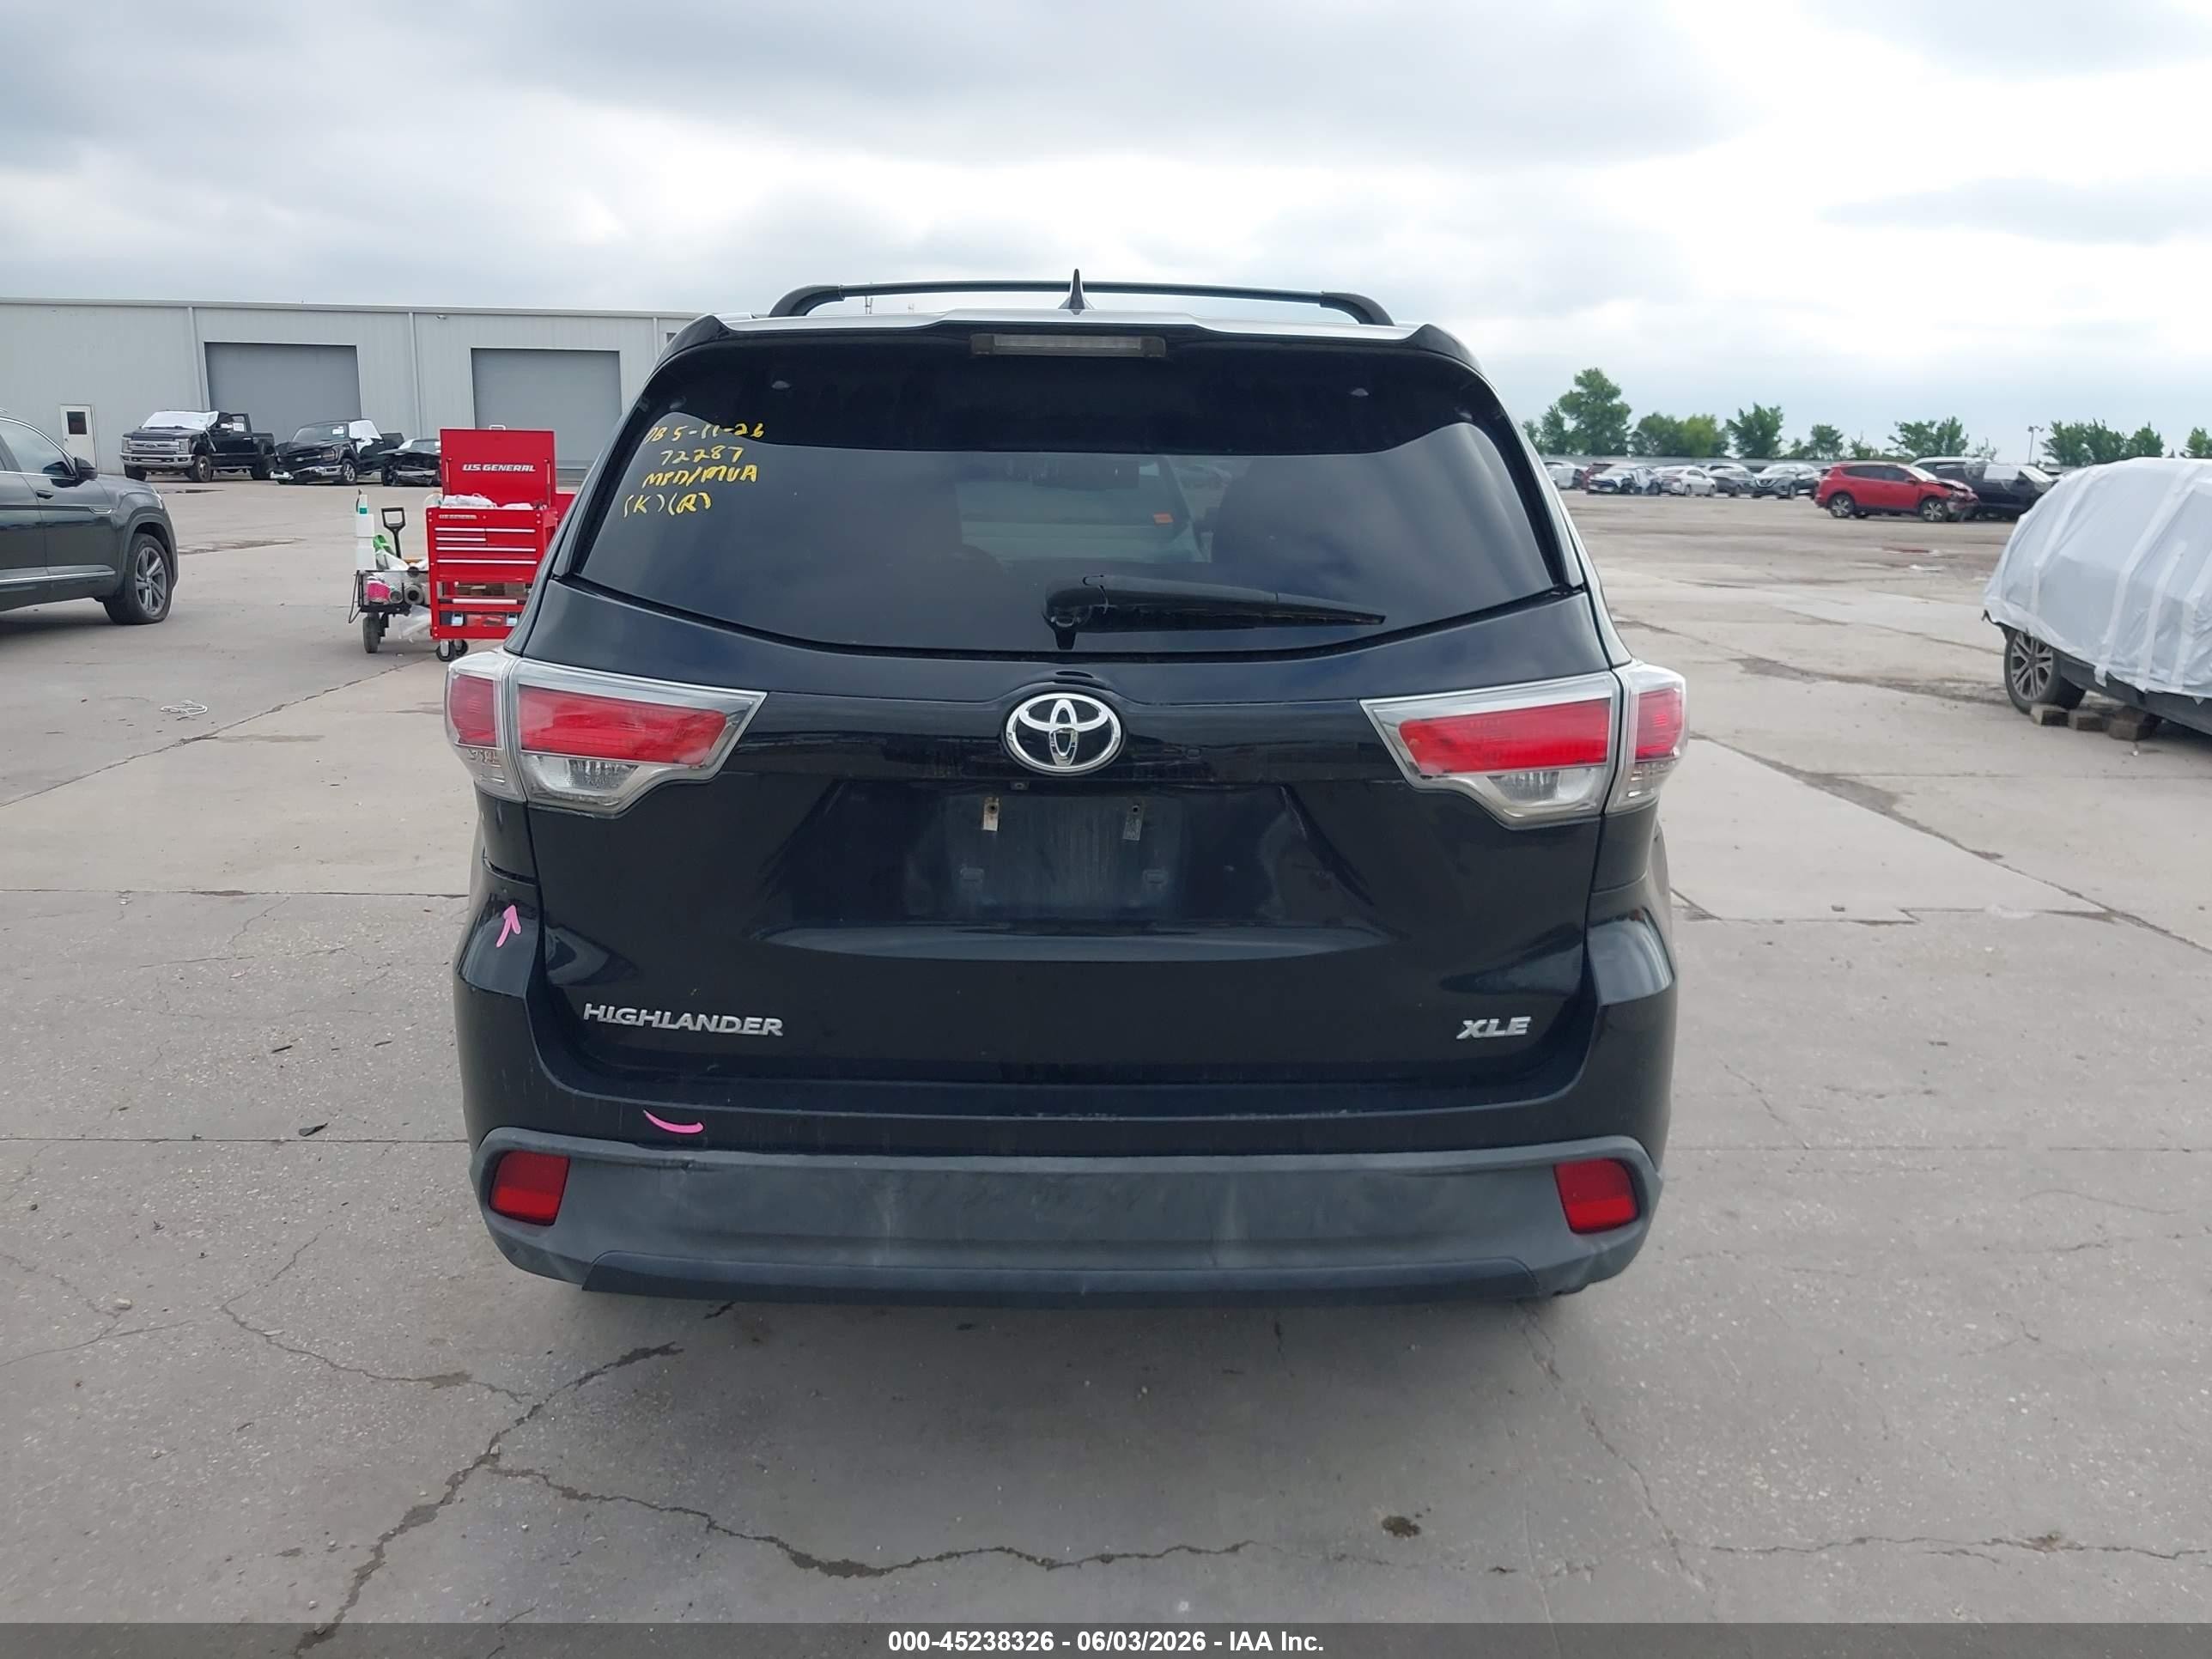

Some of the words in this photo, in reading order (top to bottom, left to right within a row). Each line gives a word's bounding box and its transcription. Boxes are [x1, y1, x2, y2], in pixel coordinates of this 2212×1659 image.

[660, 445, 744, 466] 72287
[583, 1003, 784, 1036] HIGHLANDER
[1455, 1016, 1532, 1040] XLE
